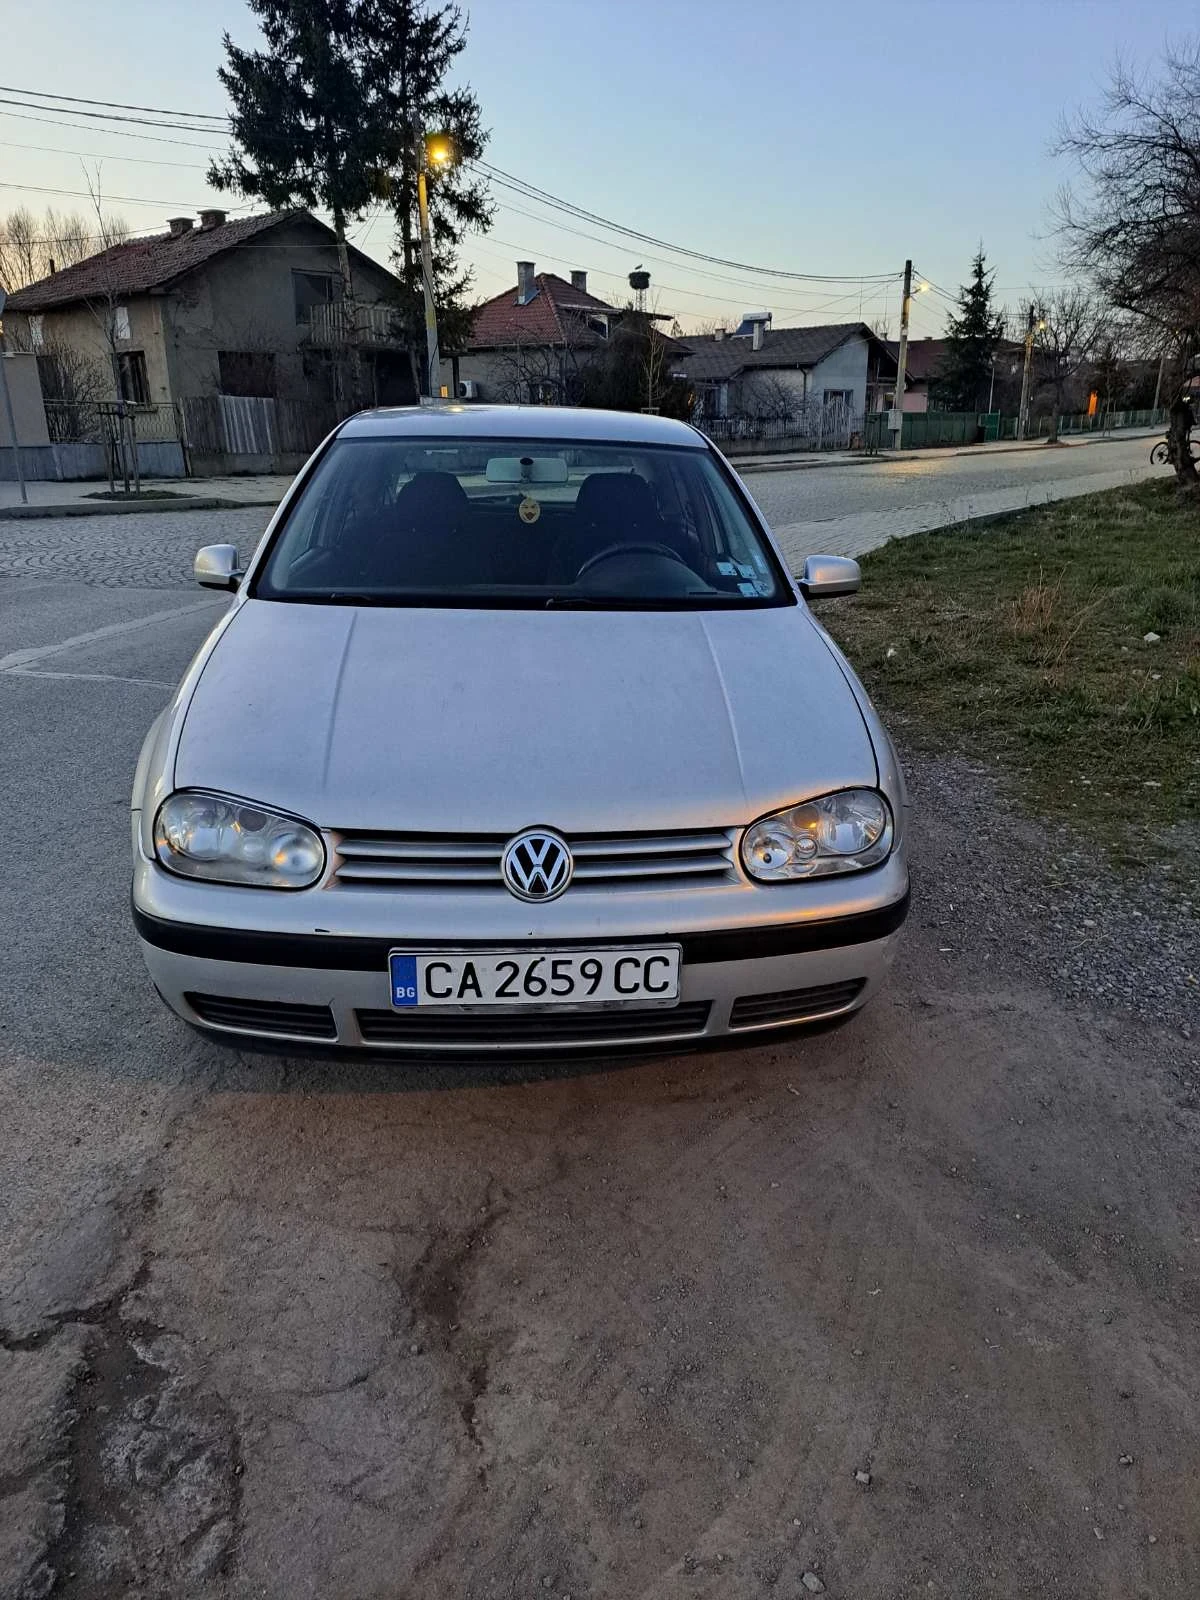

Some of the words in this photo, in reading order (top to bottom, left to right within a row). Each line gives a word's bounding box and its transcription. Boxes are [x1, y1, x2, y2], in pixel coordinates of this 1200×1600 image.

[506, 834, 570, 896] VW
[396, 986, 415, 998] BG
[425, 961, 483, 998] CA
[495, 957, 602, 997] 2659
[613, 956, 670, 994] CC
